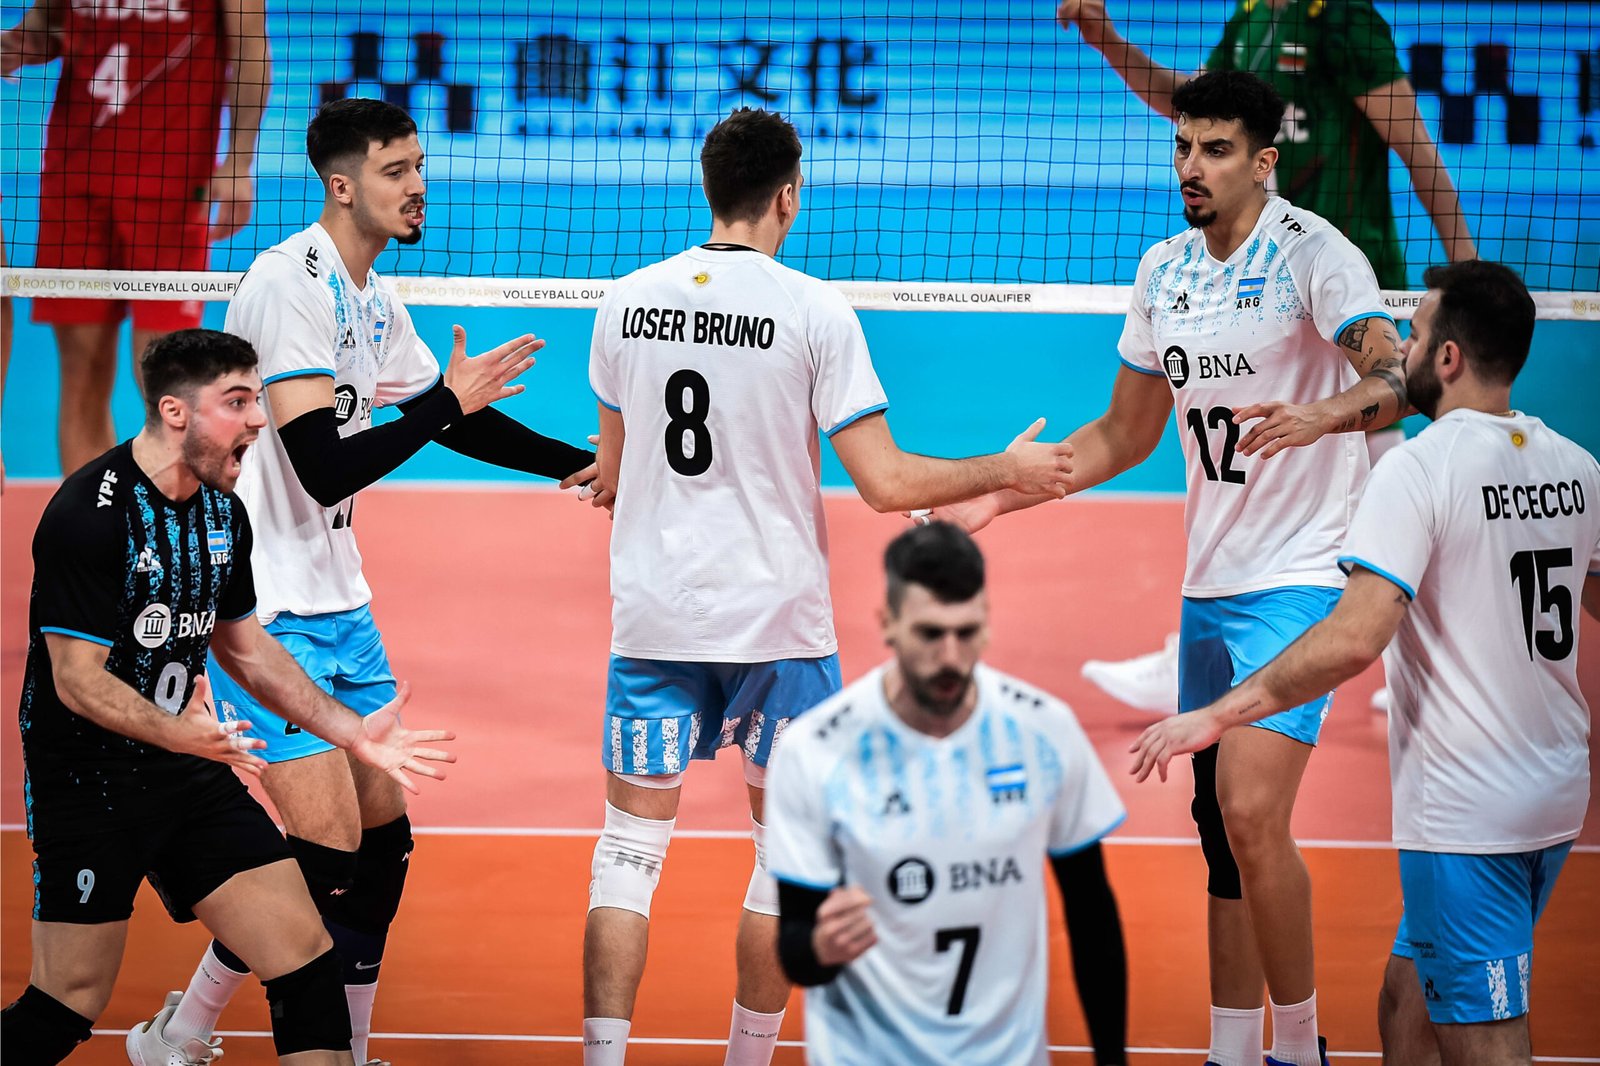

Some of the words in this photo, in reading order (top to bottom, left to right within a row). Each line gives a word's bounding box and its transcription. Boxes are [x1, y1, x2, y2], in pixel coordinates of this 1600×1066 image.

[87, 42, 129, 115] 4
[24, 279, 56, 289] ROAD
[61, 280, 75, 289] TO
[79, 281, 111, 291] PARIS
[113, 282, 188, 292] VOLLEYBALL
[503, 289, 578, 299] VOLLEYBALL
[893, 292, 968, 303] VOLLEYBALL
[970, 293, 1031, 303] QUALIFIER
[1384, 298, 1423, 307] ALIFIE
[1236, 297, 1260, 310] ARG
[622, 307, 686, 342] LOSER
[693, 311, 775, 350] BRUNO
[1198, 353, 1256, 379] BNA
[664, 368, 713, 477] 8
[1186, 406, 1246, 485] 12
[97, 469, 118, 508] YPF
[1482, 484, 1511, 521] DE
[1512, 479, 1585, 521] CECCO
[210, 552, 228, 564] ARG
[1509, 547, 1574, 662] 15
[178, 610, 216, 638] BNA
[77, 869, 95, 903] 9
[949, 857, 1022, 892] BNA
[935, 925, 981, 1016] 7
